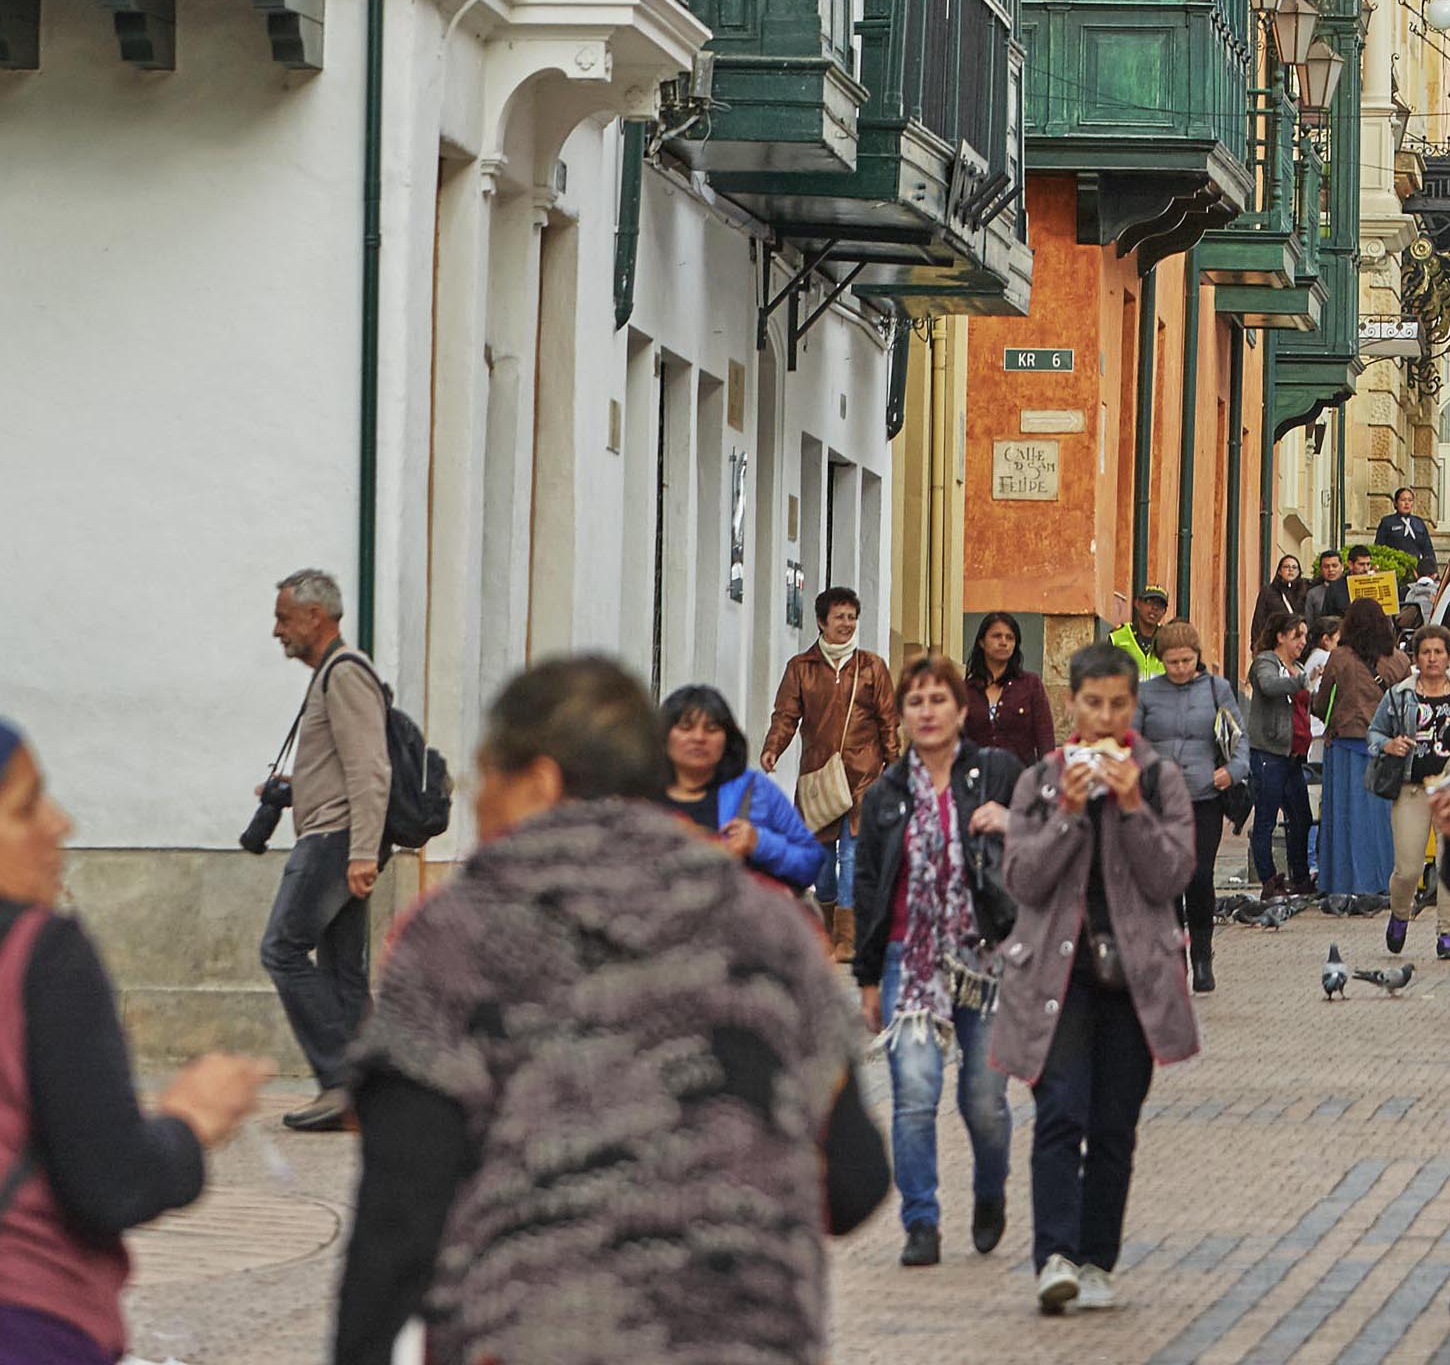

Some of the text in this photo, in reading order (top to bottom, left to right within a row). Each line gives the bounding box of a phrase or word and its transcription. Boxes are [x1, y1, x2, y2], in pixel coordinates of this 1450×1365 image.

[1018, 353, 1061, 367] KR 6
[999, 476, 1048, 494] FELIPE
